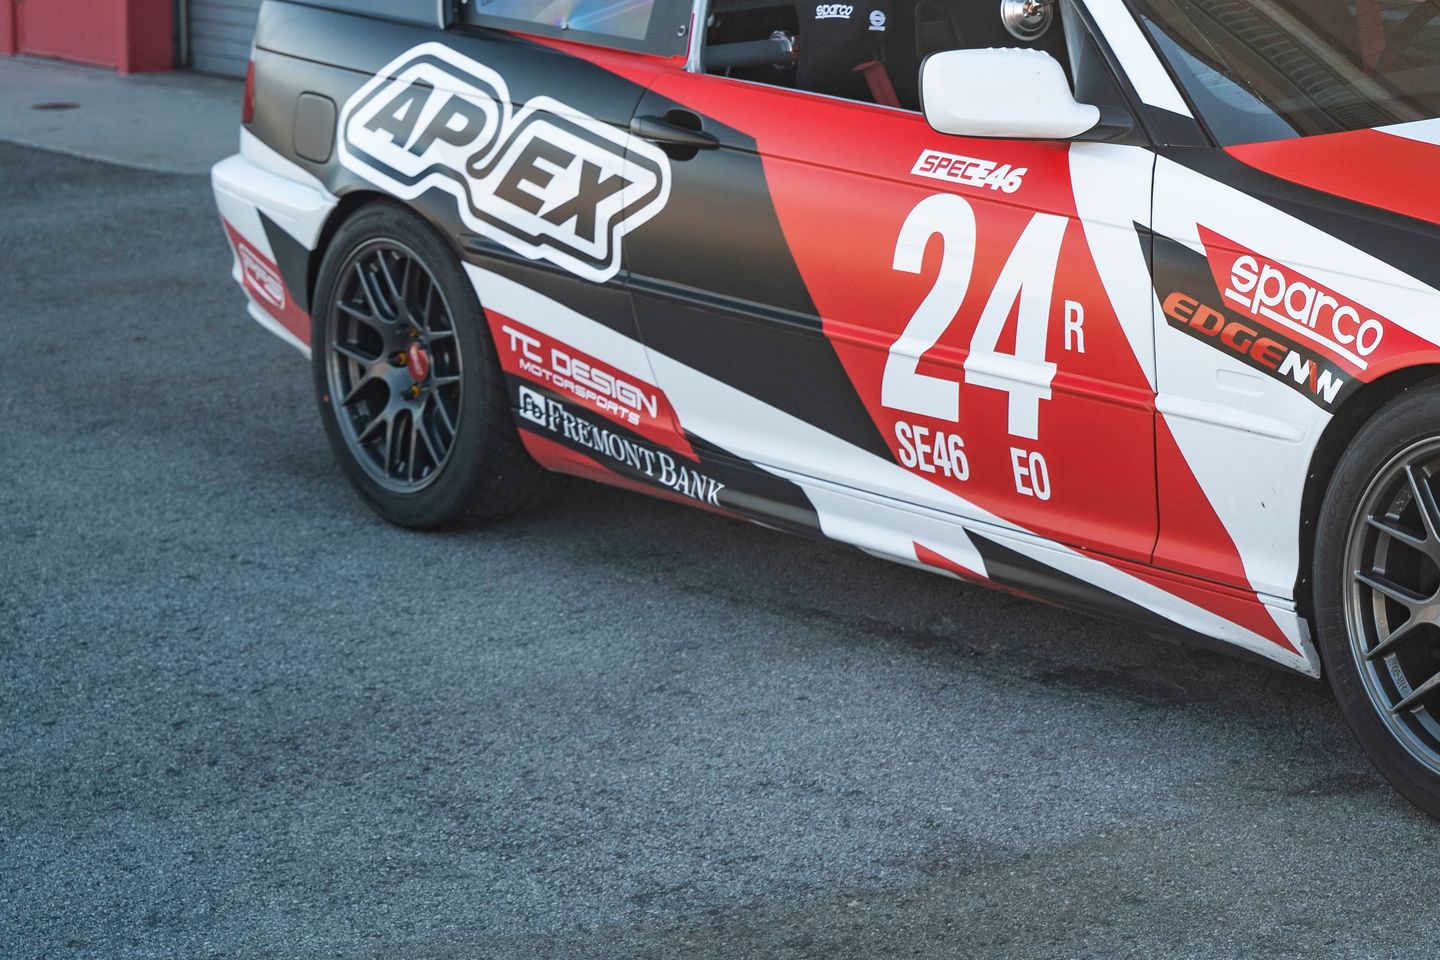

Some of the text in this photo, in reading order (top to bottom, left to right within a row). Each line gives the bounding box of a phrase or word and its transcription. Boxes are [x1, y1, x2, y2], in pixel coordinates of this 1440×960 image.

[815, 3, 854, 20] sparco
[361, 75, 637, 246] APEX
[881, 193, 1070, 441] 24
[1064, 299, 1086, 354] R
[1228, 255, 1385, 358] sparco
[501, 324, 657, 419] TC DESIGN
[518, 358, 641, 426] MOTORSPORTS
[894, 420, 970, 482] SE46
